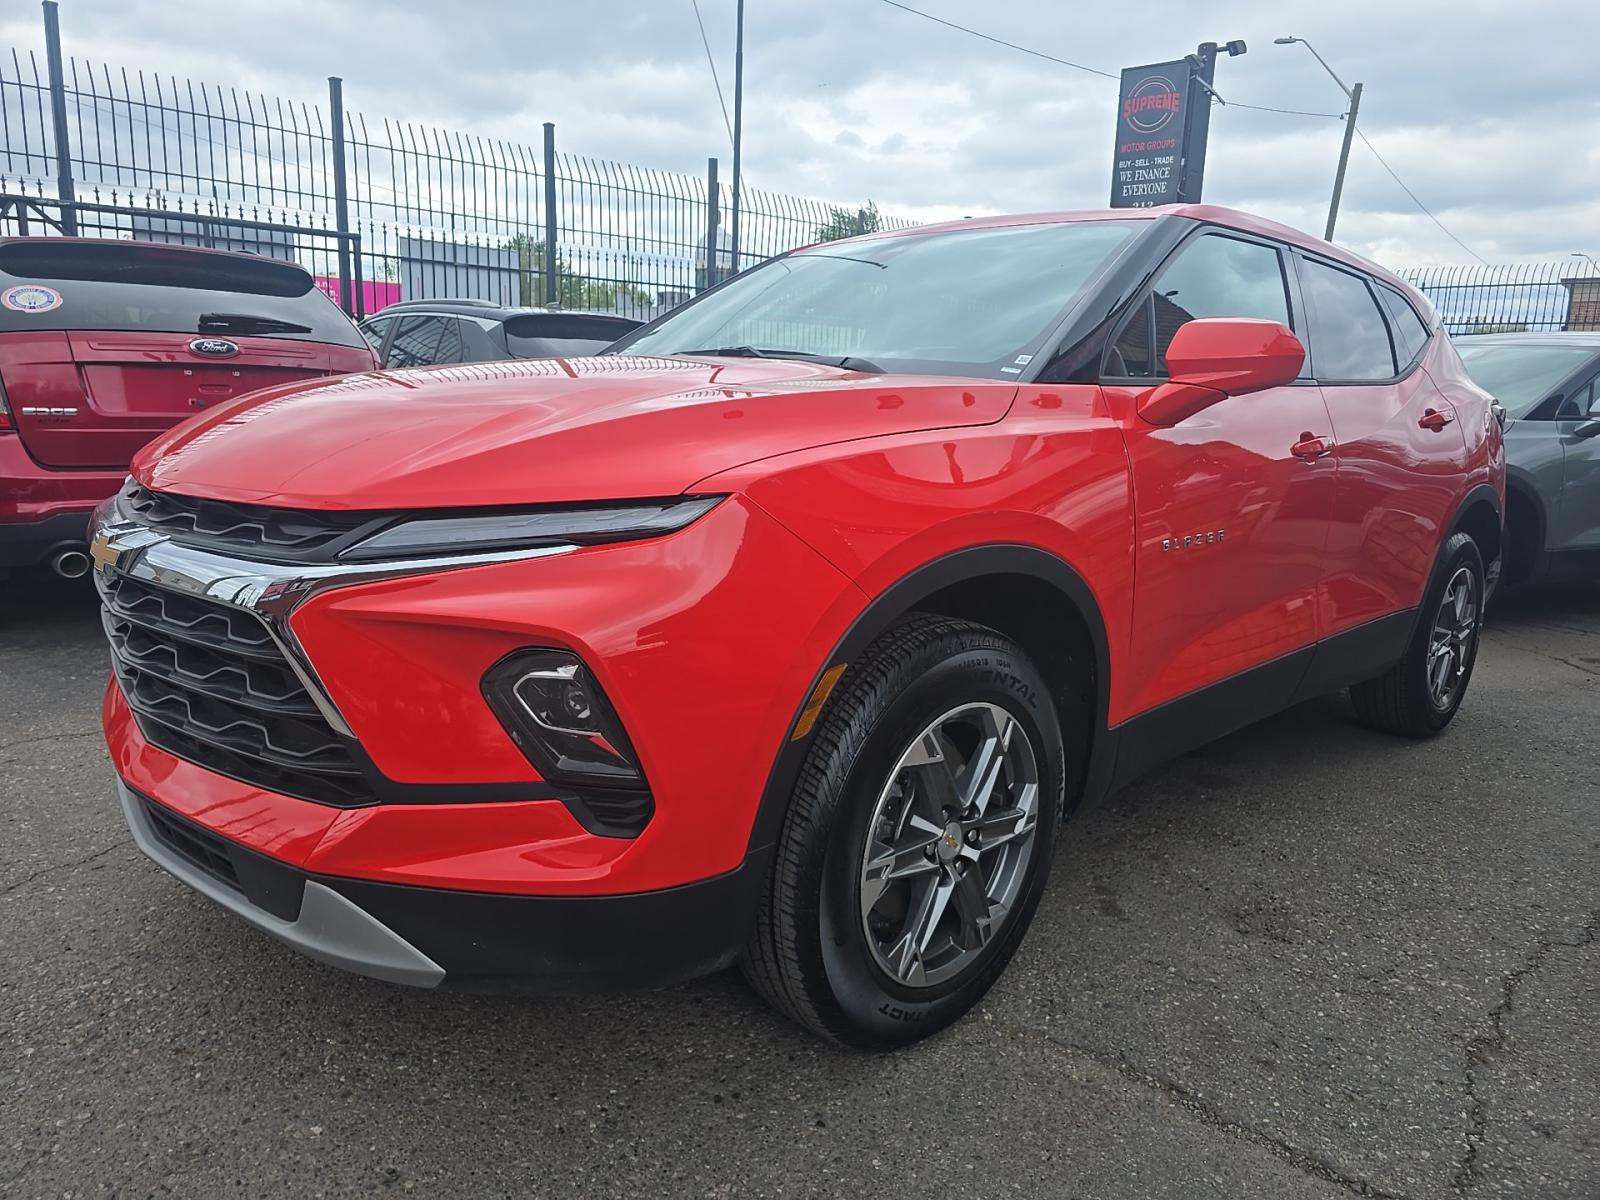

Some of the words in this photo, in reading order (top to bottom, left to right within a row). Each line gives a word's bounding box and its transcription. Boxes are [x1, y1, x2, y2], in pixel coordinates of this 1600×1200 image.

[1122, 92, 1181, 120] SUPREME
[1120, 142, 1145, 153] MOTOR
[1146, 138, 1176, 150] GROUPS
[1120, 171, 1133, 182] WE
[1134, 167, 1171, 181] FINANCE
[1122, 182, 1168, 197] EVERYONE
[202, 341, 228, 352] Ford
